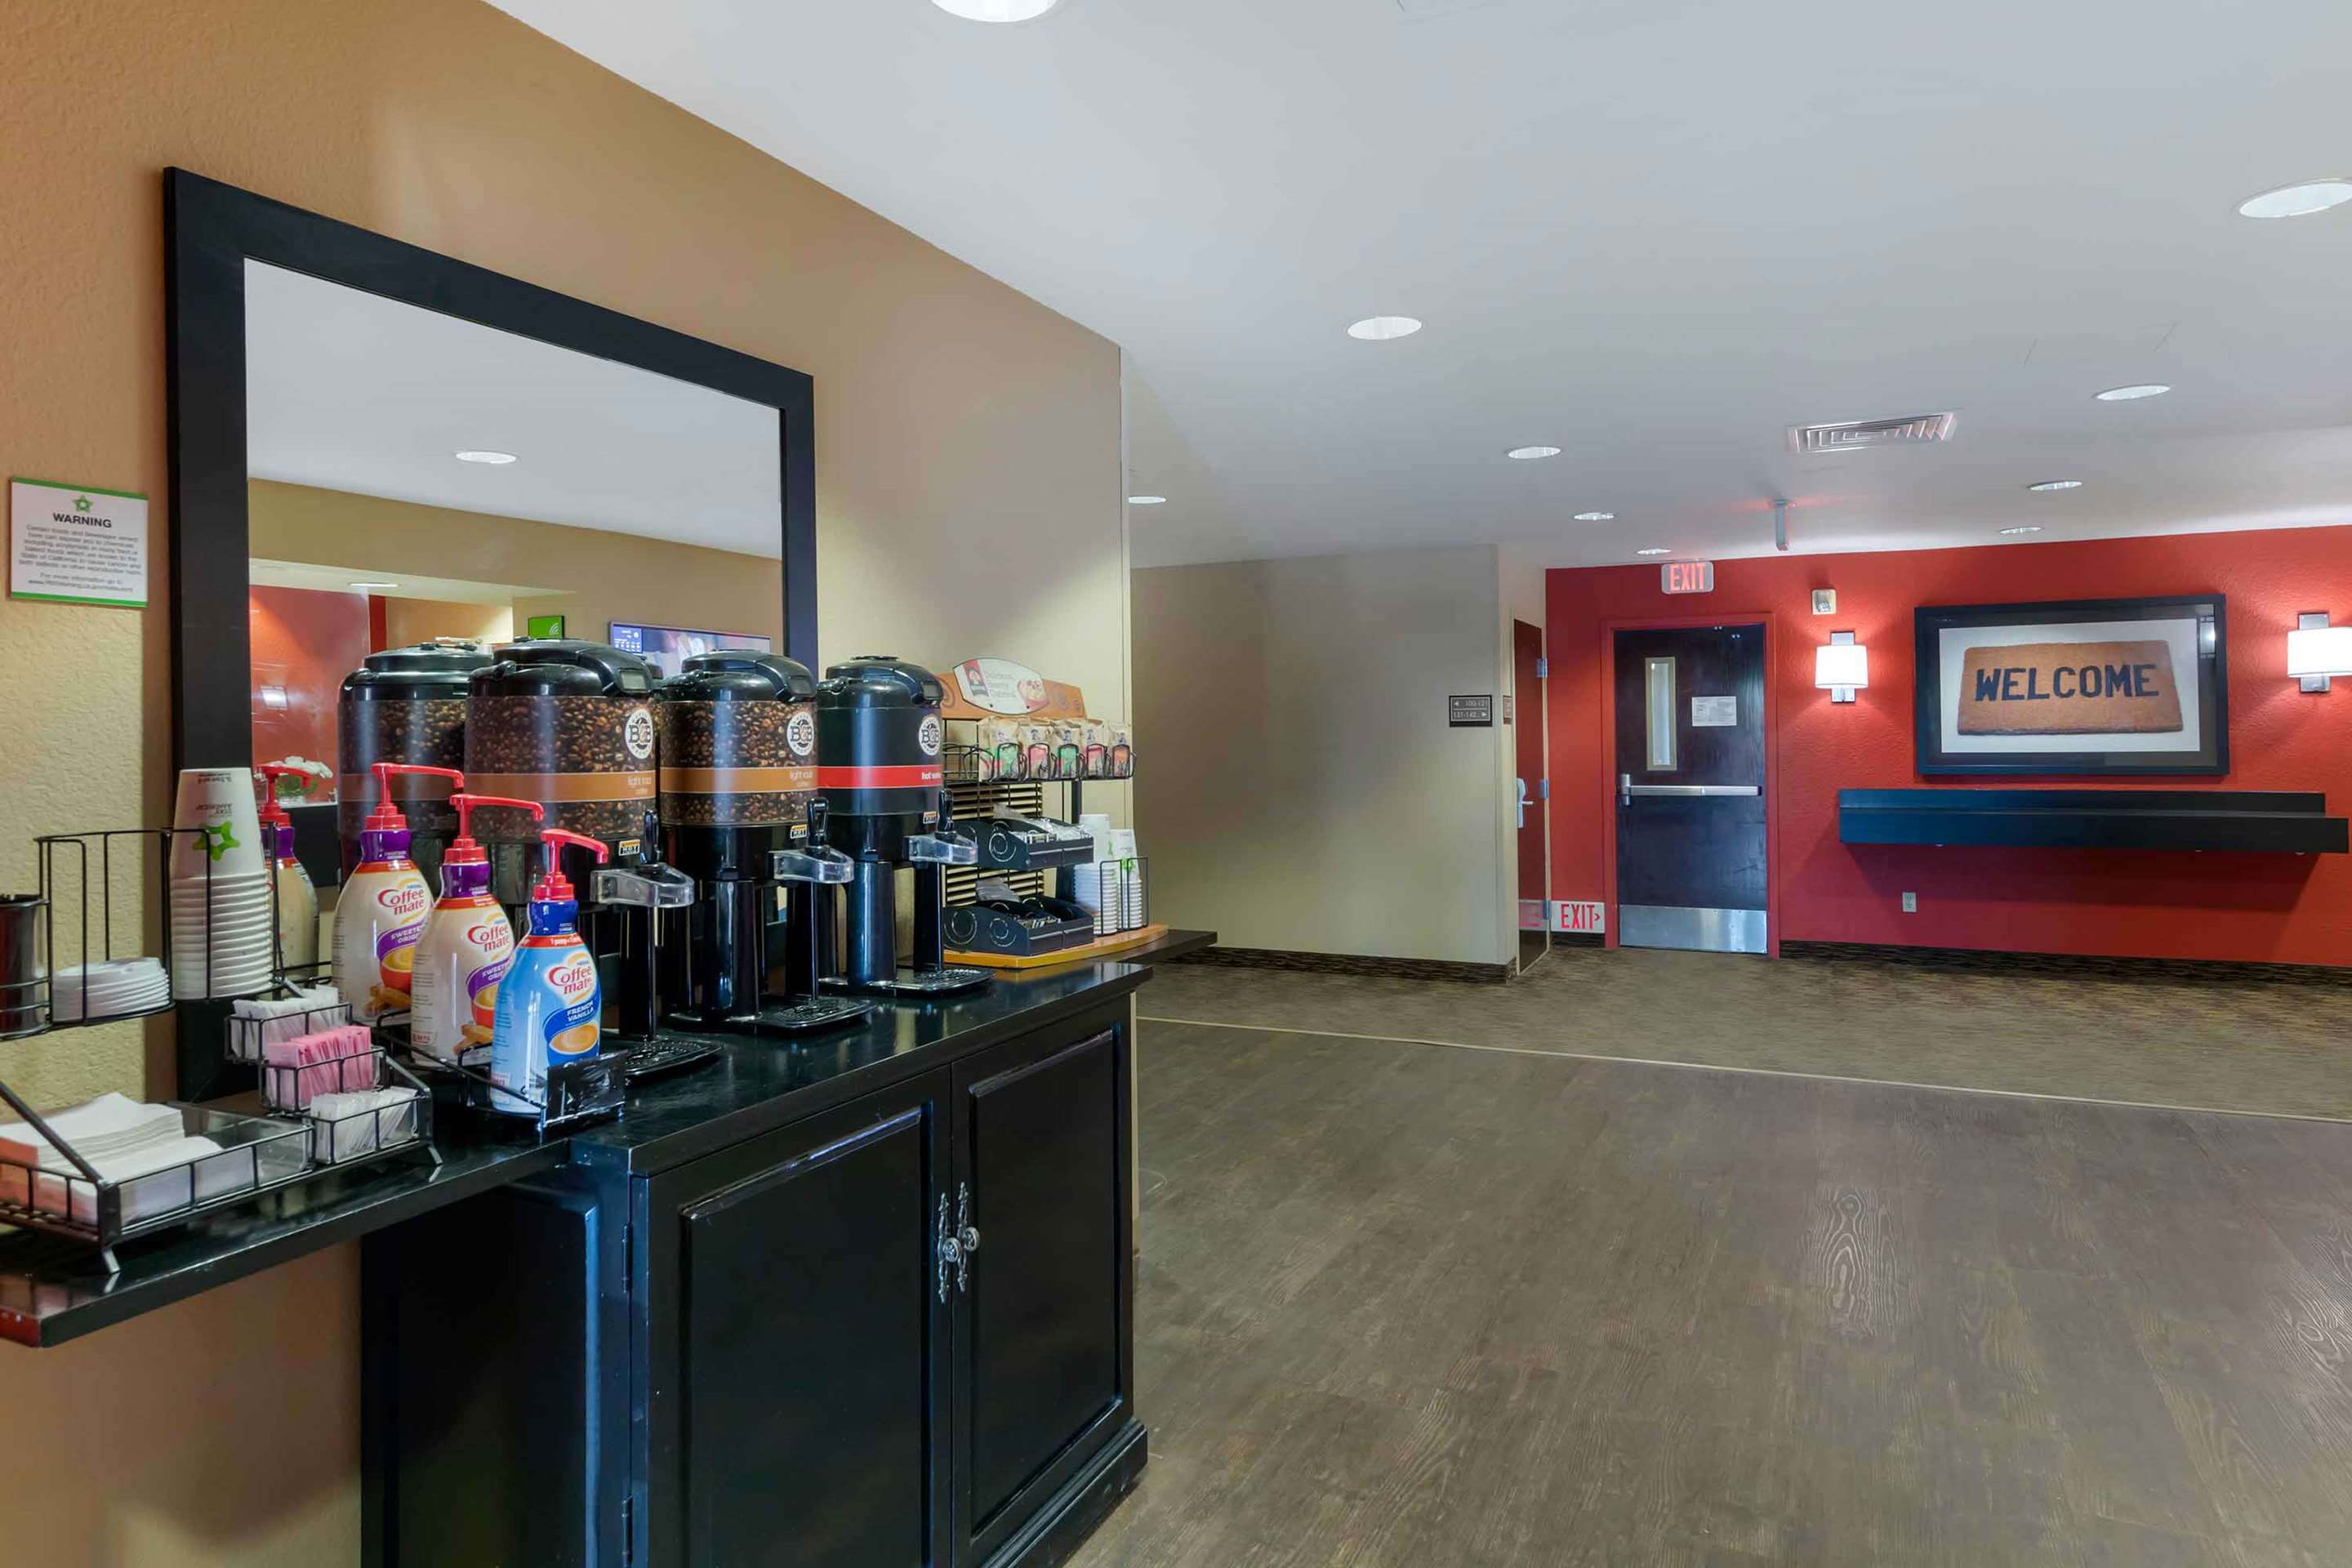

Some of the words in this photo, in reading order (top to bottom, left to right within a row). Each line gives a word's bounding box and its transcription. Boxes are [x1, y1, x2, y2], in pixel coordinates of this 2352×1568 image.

[52, 512, 112, 528] WARNING
[1670, 562, 1706, 590] EXIT
[1975, 664, 2159, 702] WELCOME
[378, 889, 424, 907] Coffee
[393, 900, 424, 915] mate
[1561, 903, 1595, 929] EXIT
[467, 924, 510, 945] Coffee
[483, 936, 510, 952] mate
[548, 965, 592, 987] Coffee
[567, 1000, 594, 1017] FRENCH
[568, 1006, 595, 1022] VANILLA
